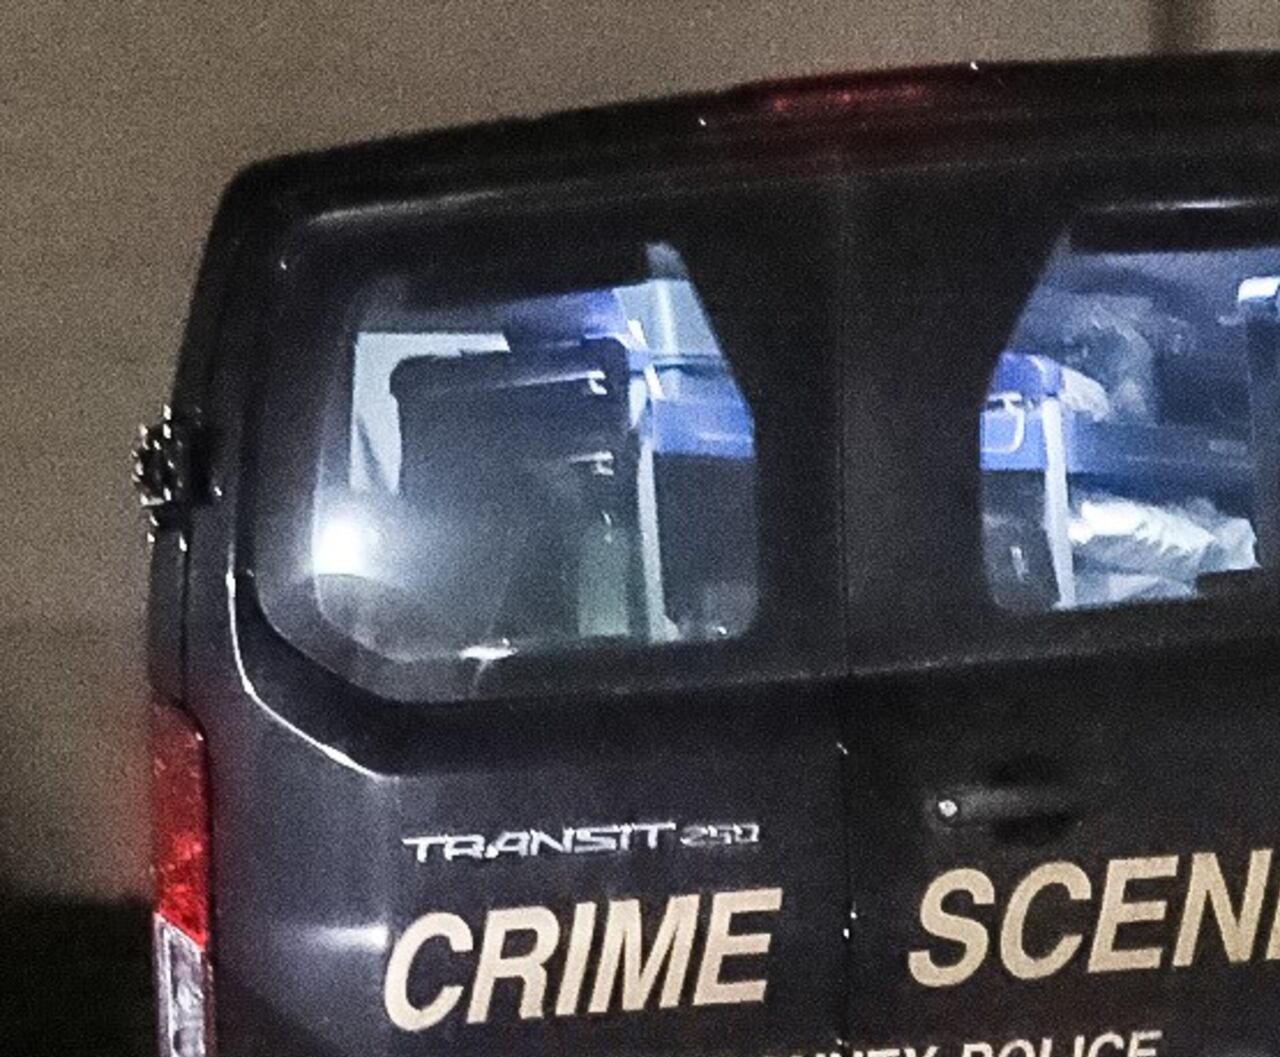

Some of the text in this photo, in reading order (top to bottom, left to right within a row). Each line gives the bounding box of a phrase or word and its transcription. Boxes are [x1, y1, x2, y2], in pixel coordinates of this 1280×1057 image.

[401, 822, 759, 863] TRANSIT 250
[383, 887, 783, 1032] CRIME
